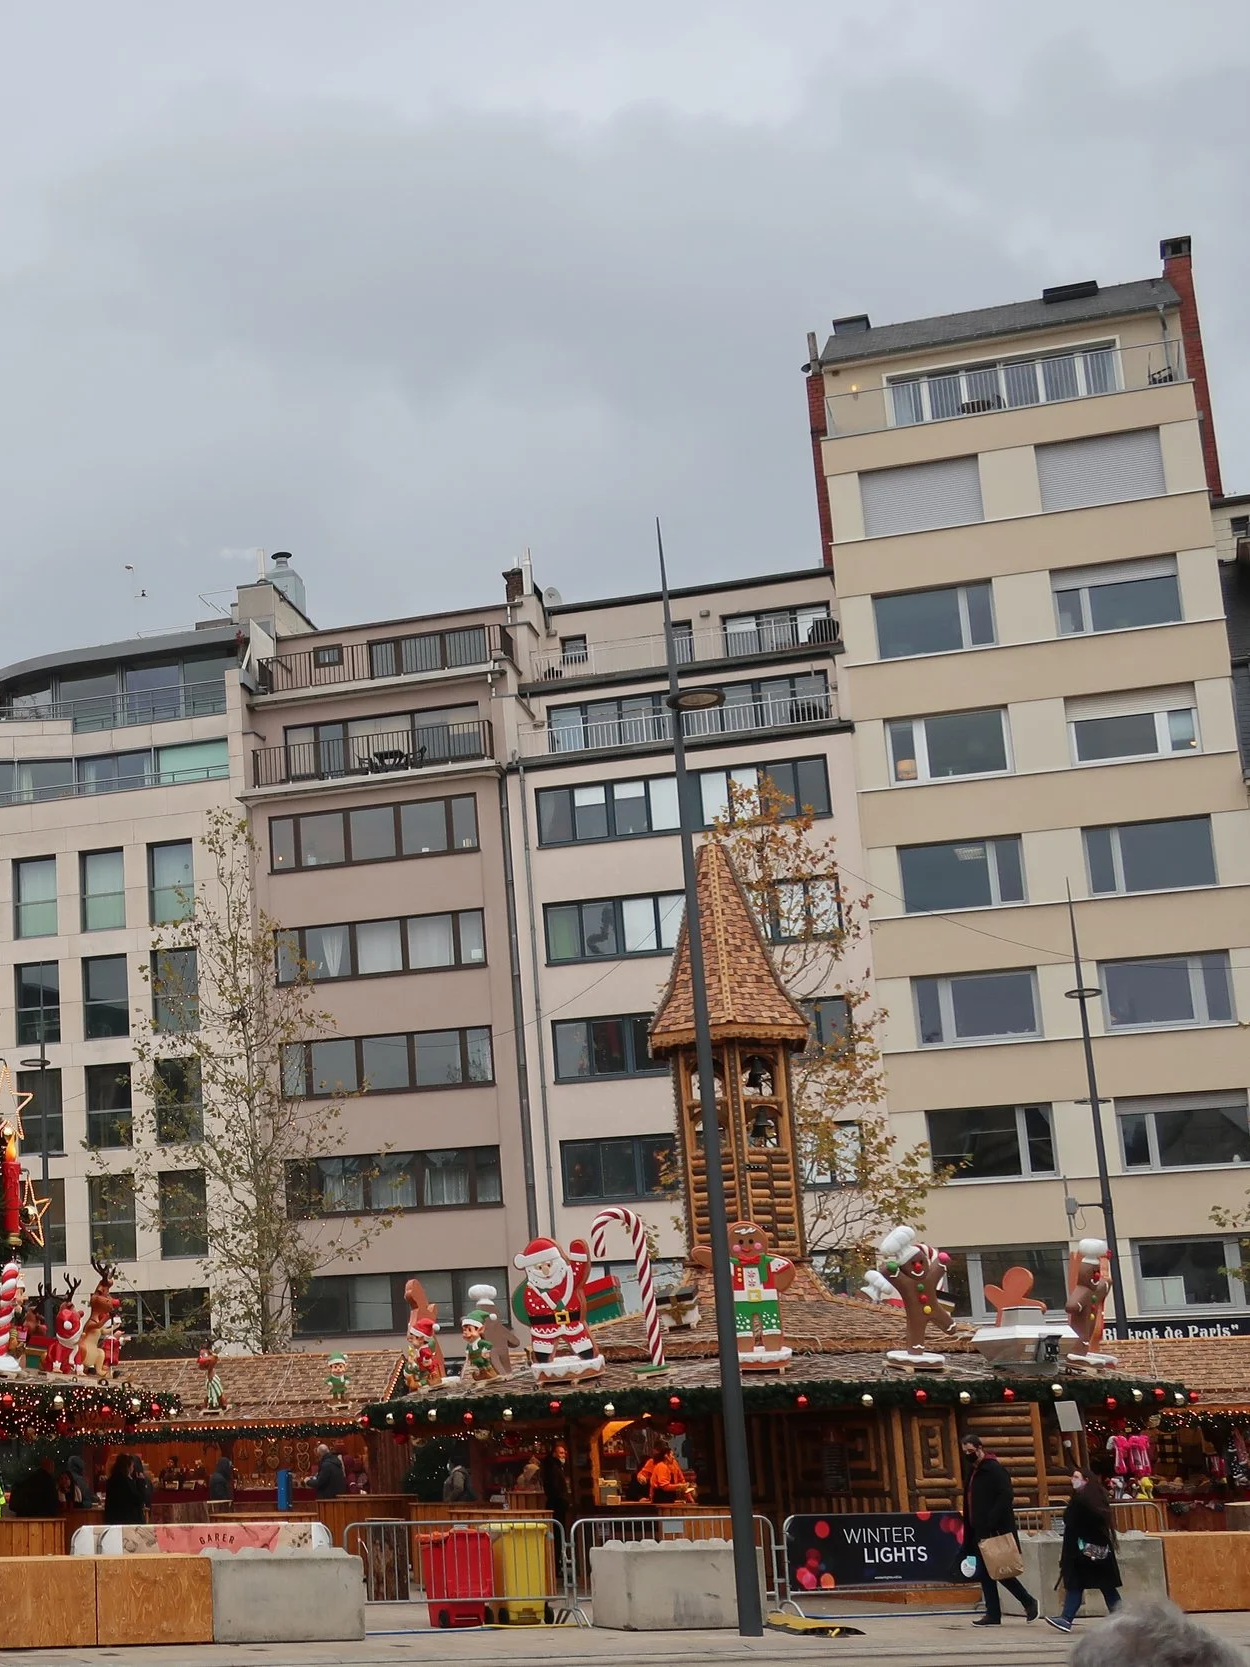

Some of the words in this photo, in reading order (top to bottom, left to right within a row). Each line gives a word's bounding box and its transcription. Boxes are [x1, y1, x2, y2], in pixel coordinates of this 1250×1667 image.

[1102, 1327, 1159, 1341] Bitrot
[1164, 1326, 1183, 1339] de
[199, 1532, 235, 1545] GARER
[843, 1526, 916, 1544] WINTER
[864, 1546, 928, 1564] LIGHTS
